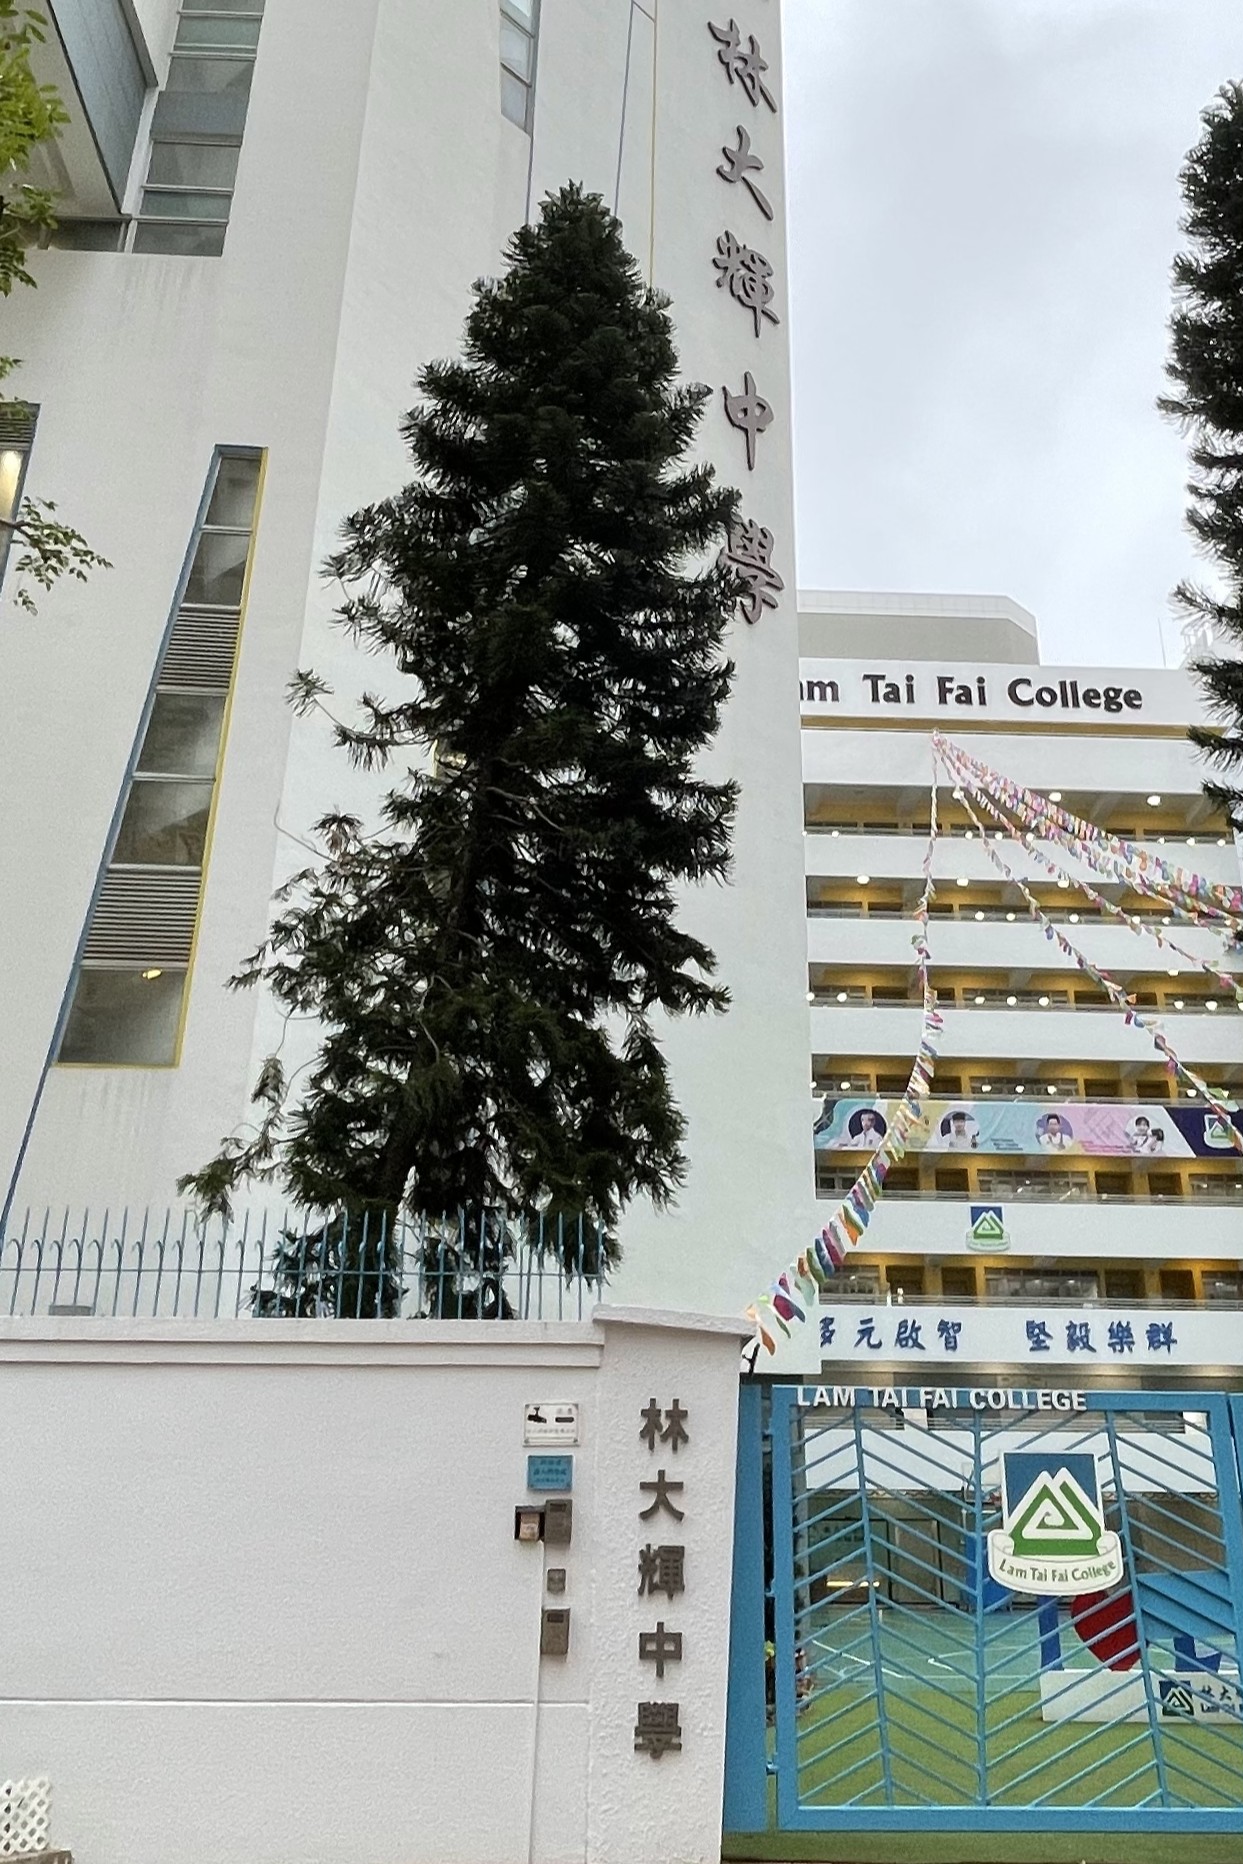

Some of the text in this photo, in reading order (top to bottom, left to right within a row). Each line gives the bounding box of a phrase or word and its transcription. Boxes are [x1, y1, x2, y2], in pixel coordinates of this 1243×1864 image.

[707, 18, 785, 625] 林大輝中學
[862, 674, 915, 704] Tai
[936, 676, 987, 706] Fai
[1007, 678, 1143, 713] College
[1025, 1319, 1178, 1355] 堅毅樂群
[797, 1386, 1088, 1411] LAM TAI FAI COLLEGE
[634, 1397, 690, 1760] 林大輝中學
[998, 1557, 1117, 1583] Lam Tai Fai College
